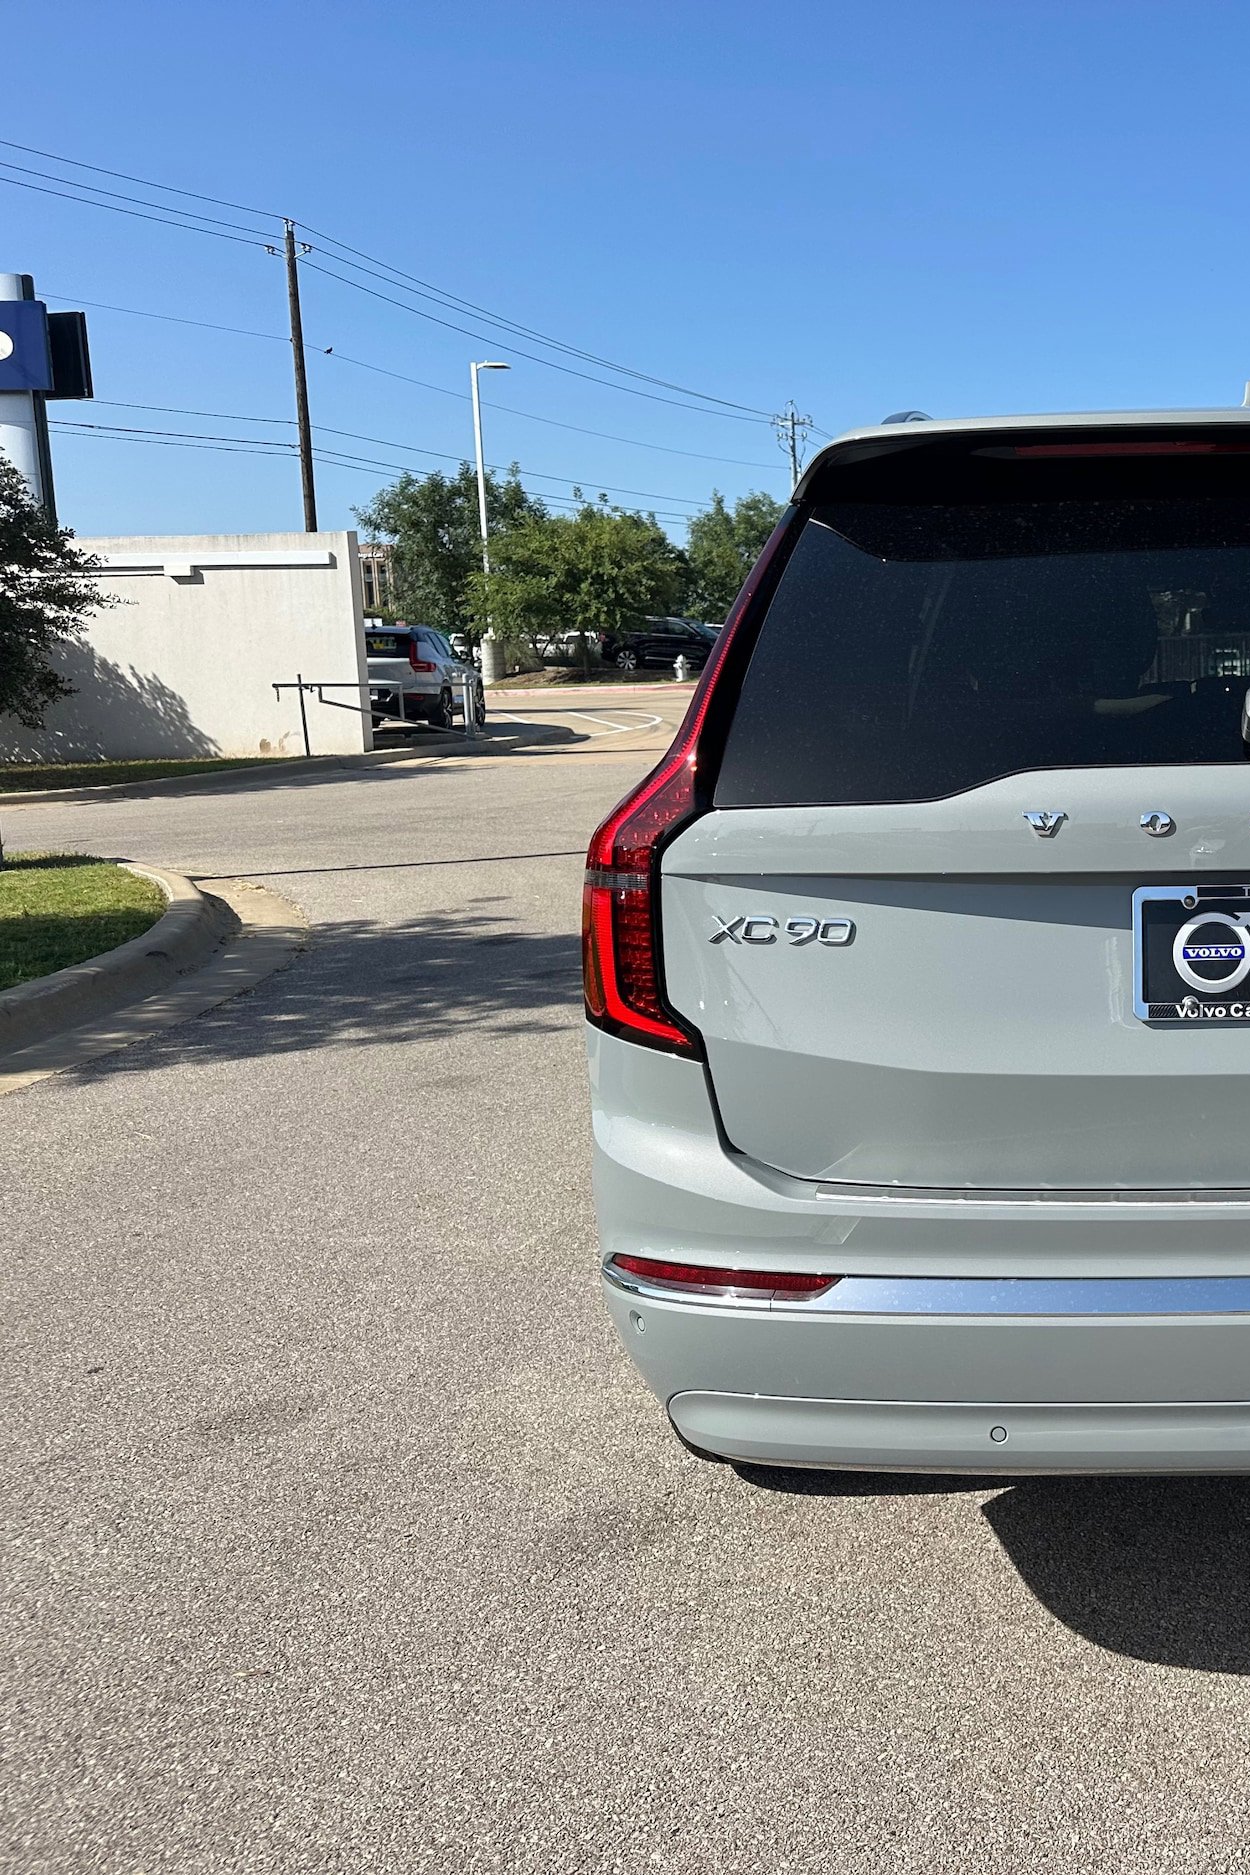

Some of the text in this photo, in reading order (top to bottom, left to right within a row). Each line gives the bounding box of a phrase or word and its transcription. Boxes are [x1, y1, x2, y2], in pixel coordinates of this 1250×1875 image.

[708, 915, 857, 947] XC90
[1185, 947, 1243, 957] VOLVO
[1175, 1004, 1226, 1018] Volvo
